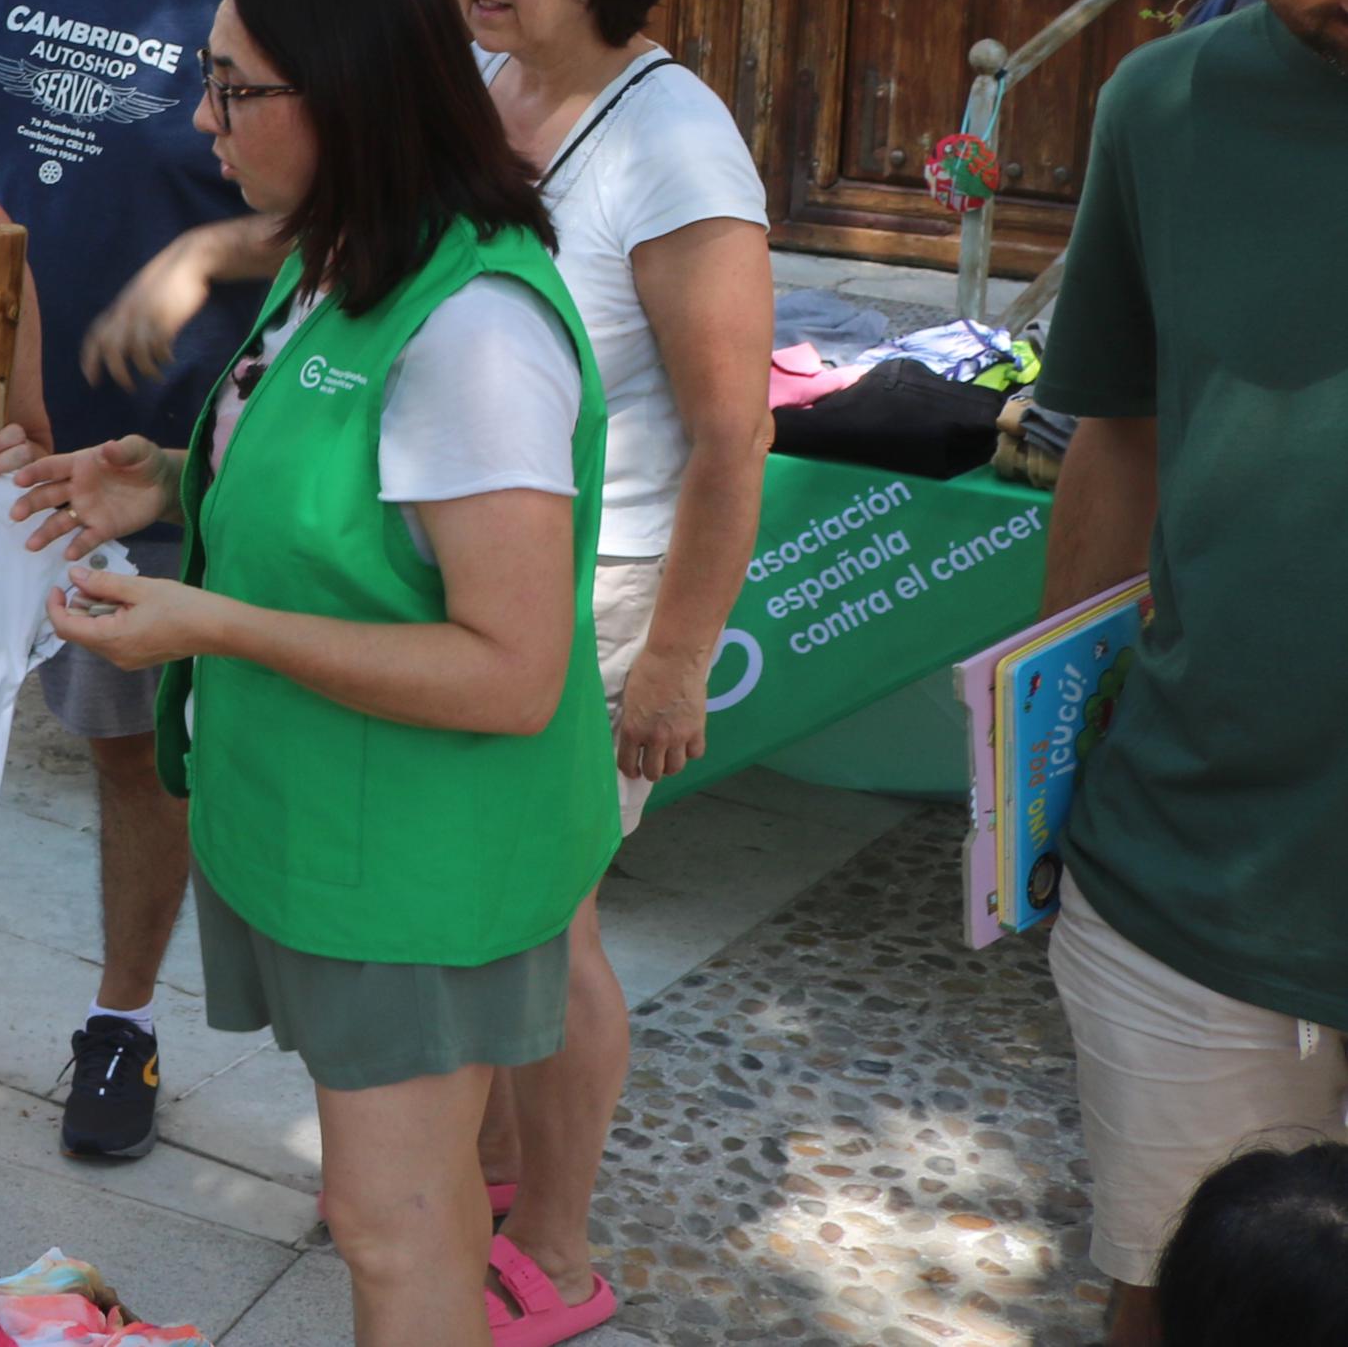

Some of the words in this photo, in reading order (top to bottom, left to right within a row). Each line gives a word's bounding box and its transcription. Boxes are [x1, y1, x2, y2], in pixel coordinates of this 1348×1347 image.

[6, 5, 183, 75] CAMBRIDGE
[29, 40, 137, 80] AUTOSHOP
[32, 71, 111, 114] SERVICE
[17, 125, 65, 146] Cambridge
[35, 143, 58, 157] Since
[746, 480, 912, 582] asociación
[766, 529, 911, 619] española
[789, 588, 894, 654] contra
[895, 563, 929, 600] el
[930, 506, 1043, 581] cáncer
